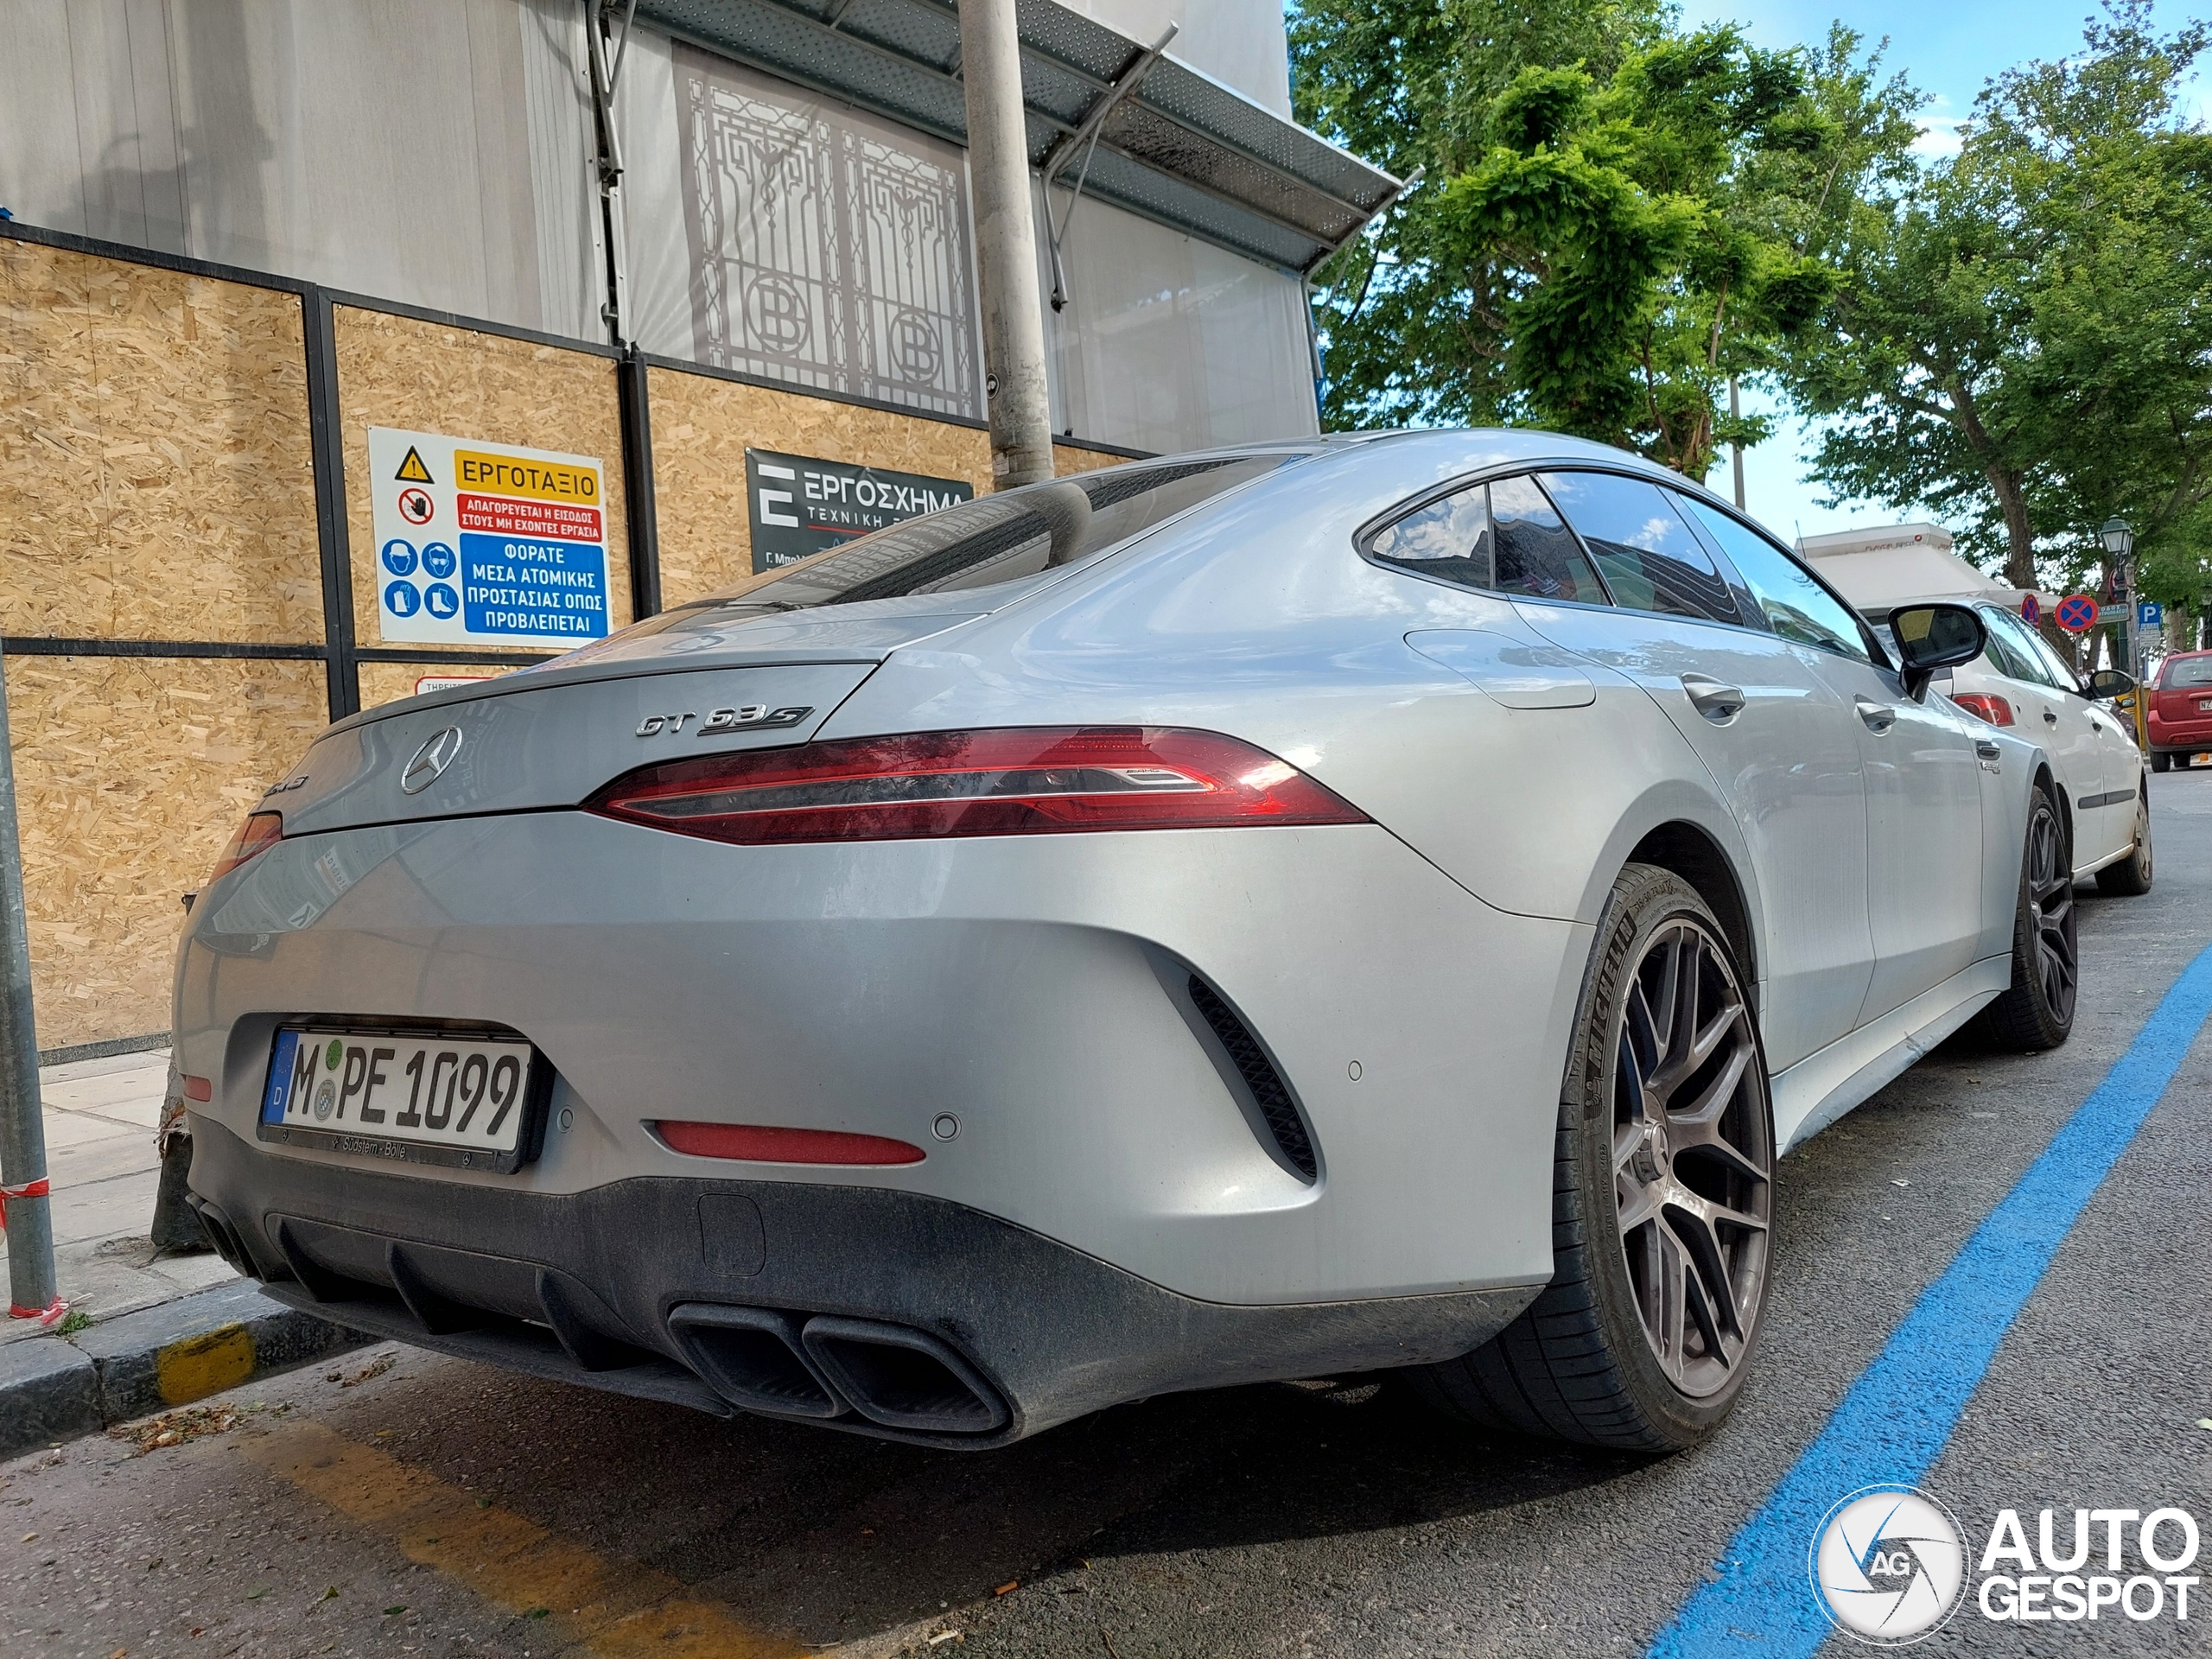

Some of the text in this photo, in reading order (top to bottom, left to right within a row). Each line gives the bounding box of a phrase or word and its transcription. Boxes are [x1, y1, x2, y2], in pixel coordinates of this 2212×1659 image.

[462, 459, 594, 497] ΕΡΓΟΤΑΞΙΟ
[467, 499, 594, 524] ΑΠΑΓΟΡΕΥΕΤΑΙ Η ΕΙΣΟΔΟΣ
[807, 505, 882, 528] ΤΕΧΝΙΚΗ
[461, 513, 600, 538] ΣΤΟΥΣ ΜΗ ΕΧΟΝΤΕΣ ΕΡΓΑΣΙΑ
[504, 543, 565, 564] ΦΟΡΑΤΕ
[473, 563, 596, 588] ΜΕΣΑ ΑΤΟΜΙΚΗΣ
[467, 587, 603, 611] ΠΡΟΣΤΑΣΙΑΣ ΟΠΩΣ
[486, 611, 590, 632] ΠΡΟΒΛΕΠΕΤΑΙ
[2144, 606, 2157, 622] P
[635, 711, 696, 736] GT
[1587, 914, 1636, 1070] MICHELIN
[273, 1085, 282, 1106] D
[287, 1044, 320, 1116] M
[395, 1049, 520, 1136] 1099
[342, 1136, 378, 1156] Südstern
[384, 1141, 406, 1159] Bölle
